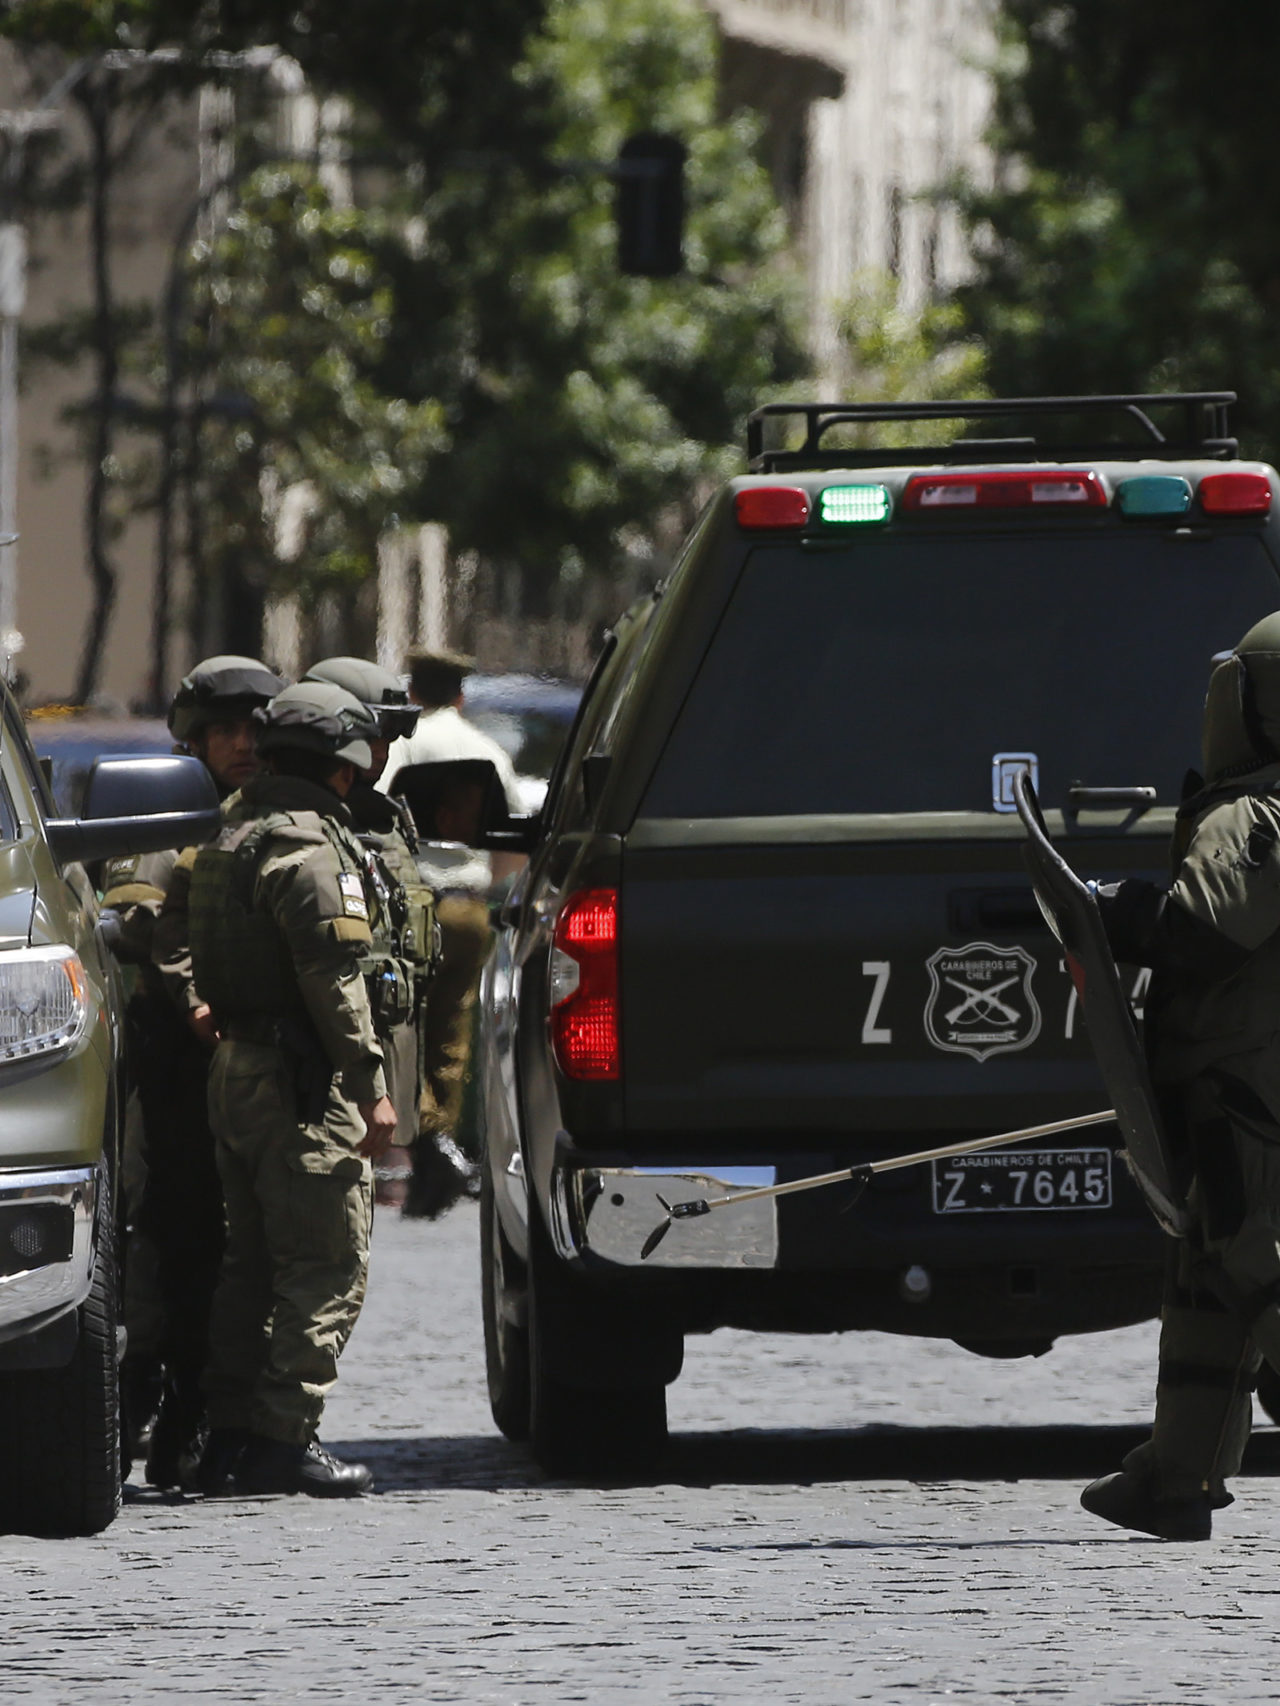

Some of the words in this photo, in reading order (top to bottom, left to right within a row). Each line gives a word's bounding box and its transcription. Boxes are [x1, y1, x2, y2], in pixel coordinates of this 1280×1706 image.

[941, 960, 1003, 971] CARABINEROS
[966, 969, 993, 981] CHILE
[861, 961, 892, 1044] Z
[952, 1155, 1034, 1168] CARABINEROS
[1038, 1154, 1053, 1165] DE
[1057, 1153, 1091, 1165] CHILE
[944, 1172, 966, 1207] Z
[1008, 1169, 1104, 1204] 7645
